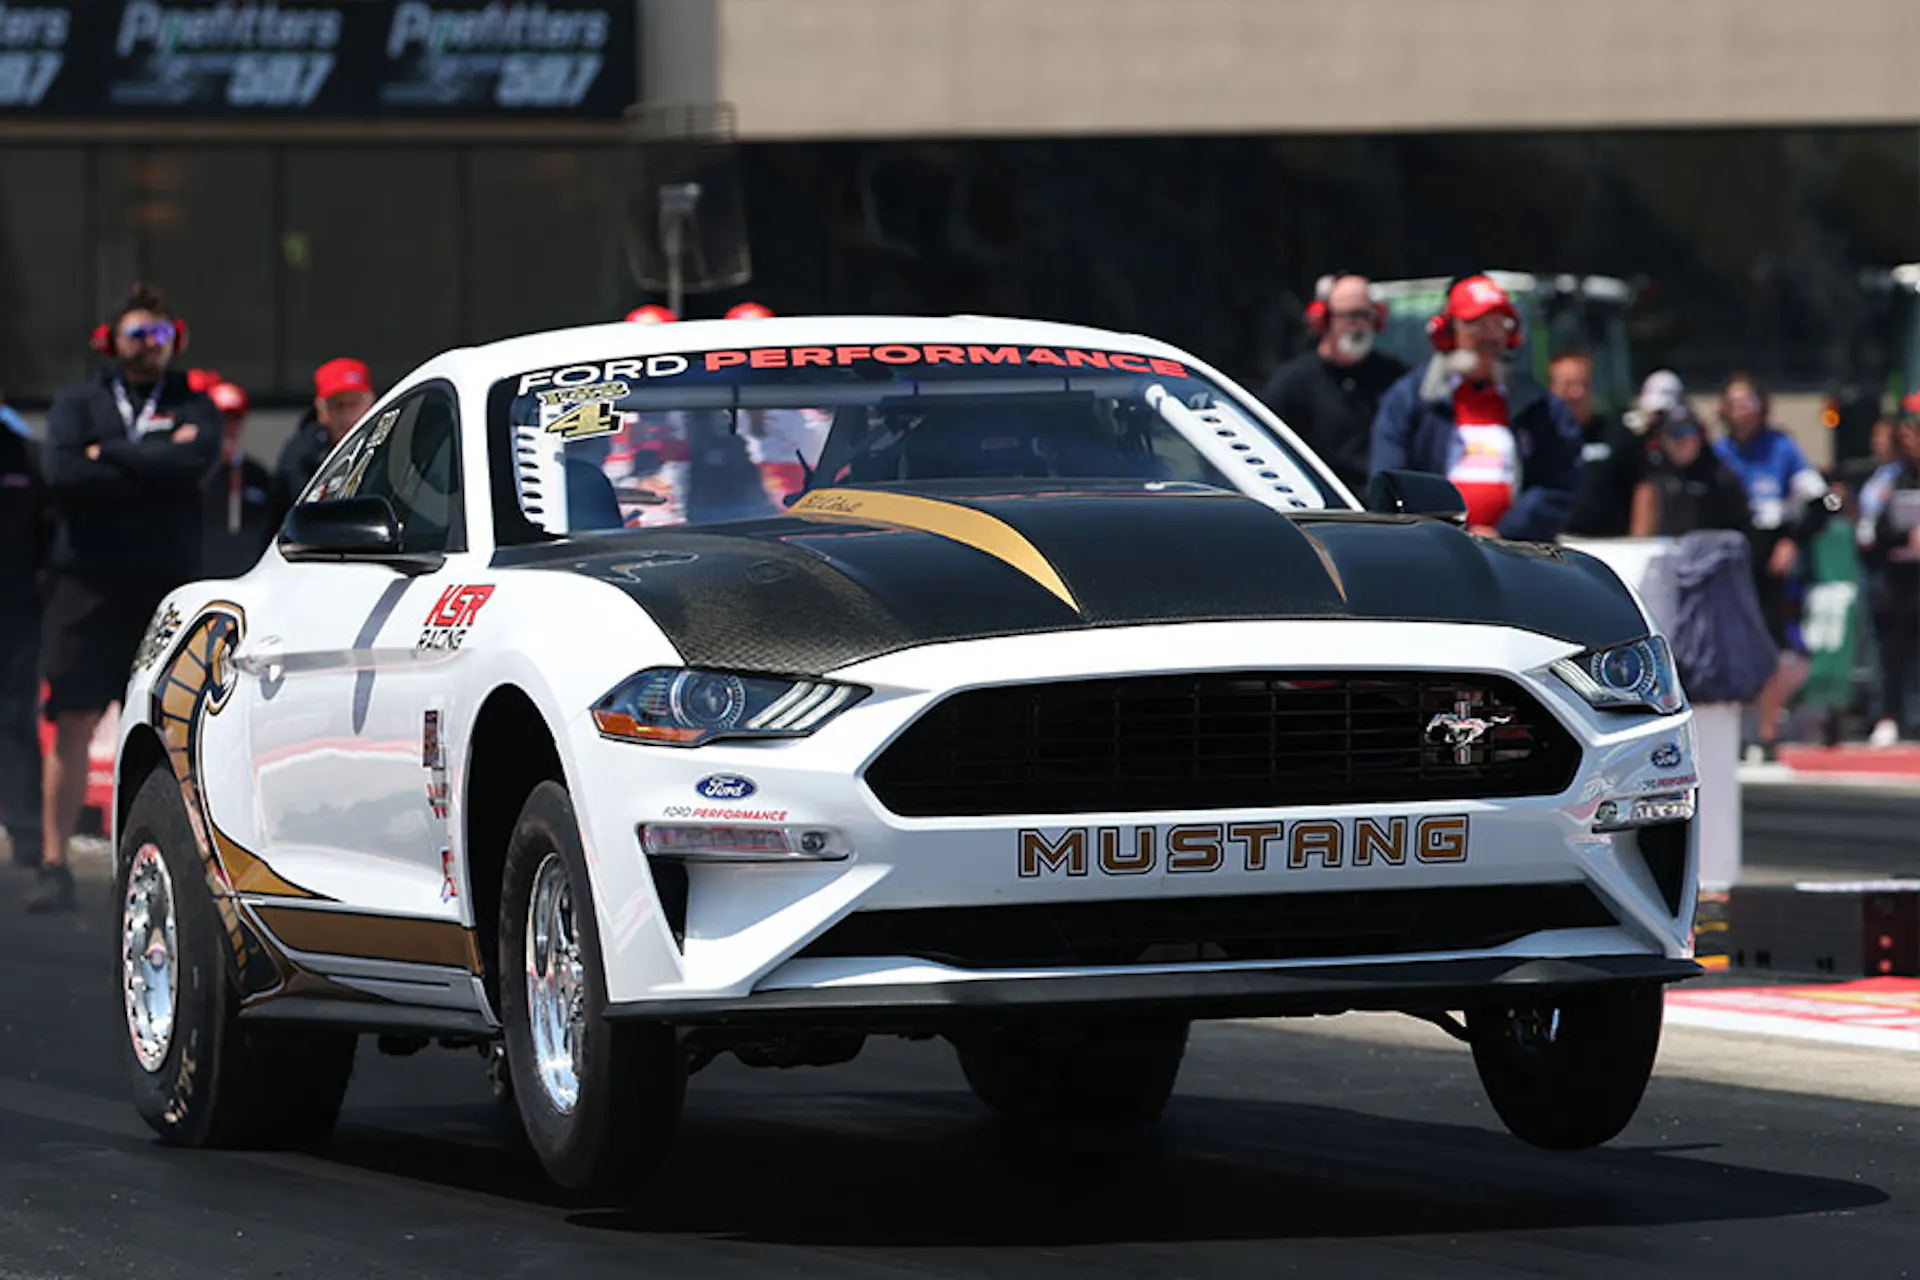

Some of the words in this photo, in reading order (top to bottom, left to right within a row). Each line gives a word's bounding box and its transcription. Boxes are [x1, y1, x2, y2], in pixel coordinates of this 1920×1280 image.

[518, 355, 688, 396] FORD
[704, 345, 1189, 379] PERFORMANCE
[424, 583, 496, 627] KSR
[704, 777, 745, 798] Ford
[663, 806, 692, 818] FORD
[692, 807, 788, 821] PERFORMANCE
[1018, 814, 1469, 877] MUSTANG
